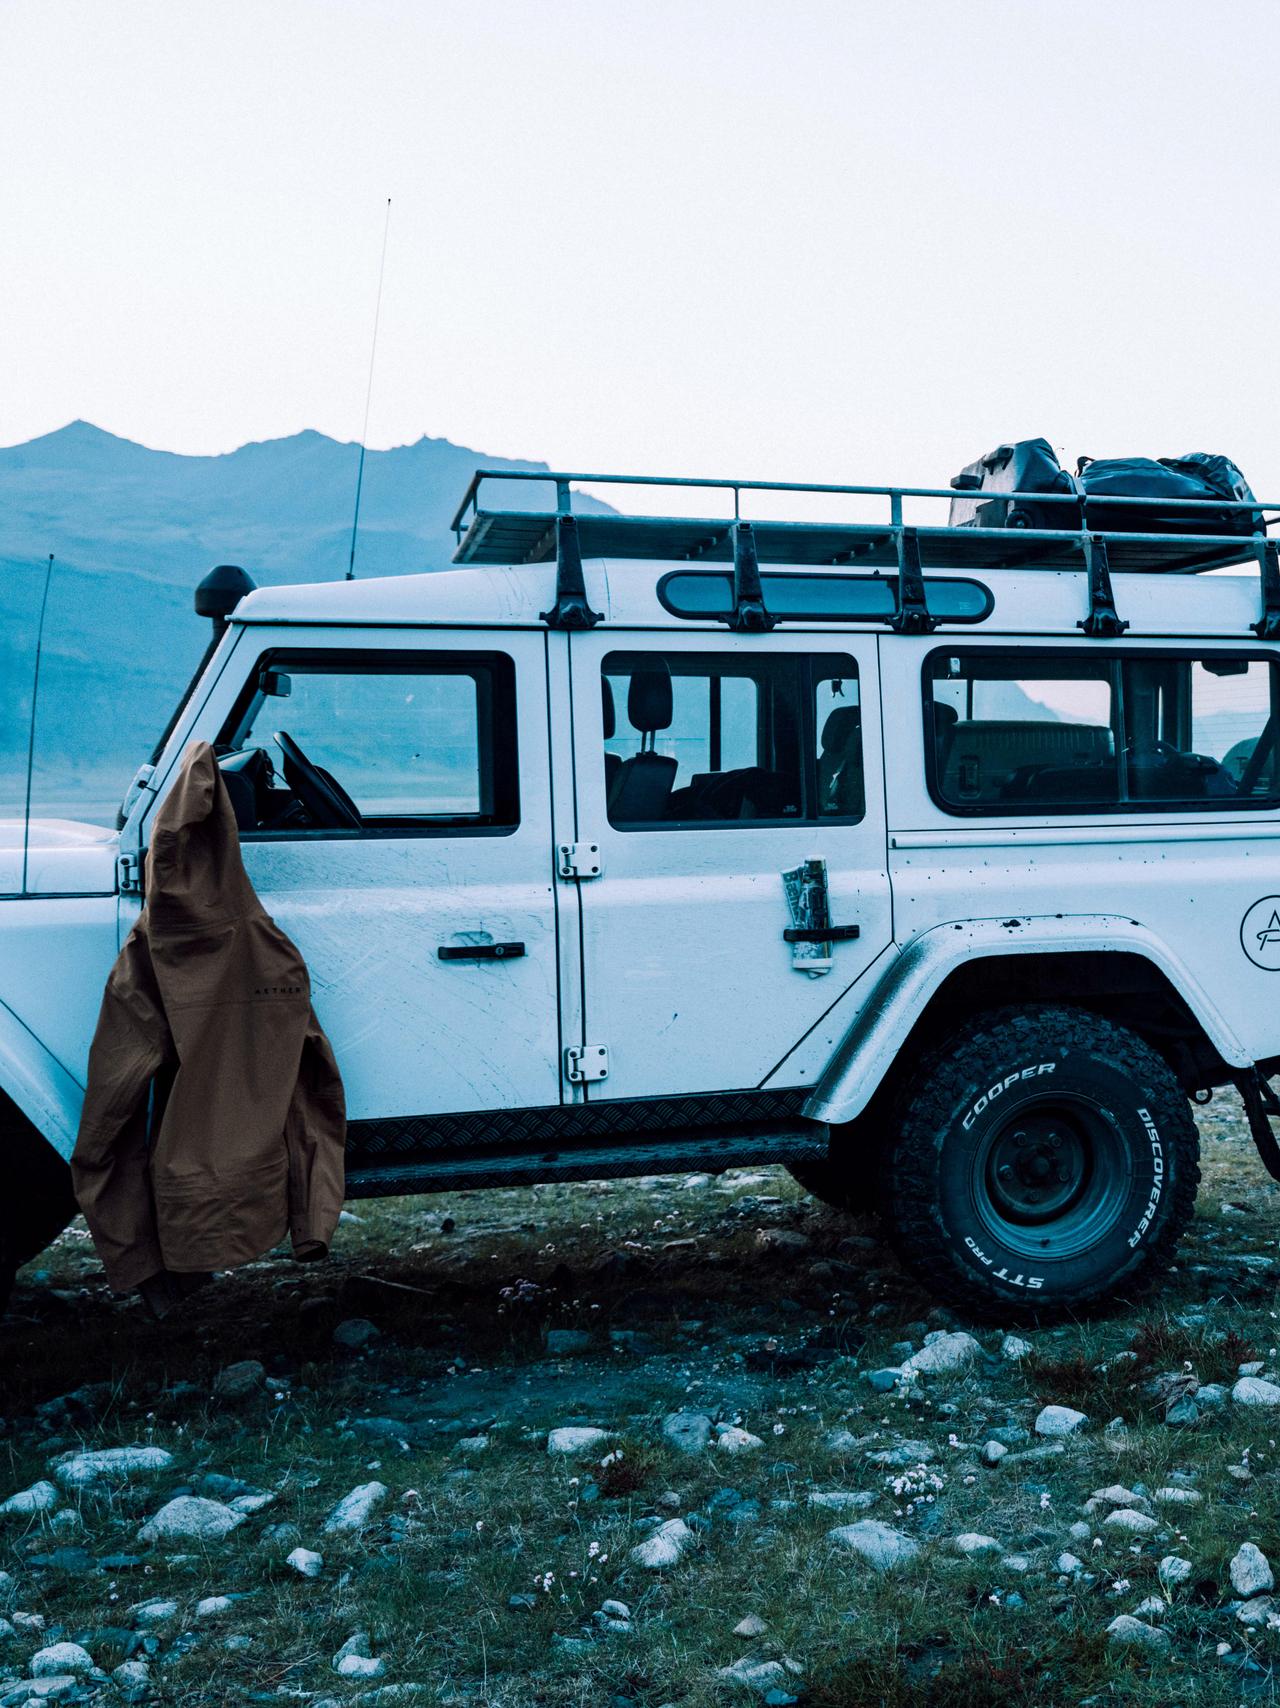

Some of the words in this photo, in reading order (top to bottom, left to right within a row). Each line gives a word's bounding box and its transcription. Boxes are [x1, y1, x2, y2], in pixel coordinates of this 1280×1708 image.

[961, 1062, 1057, 1131] COOPER
[1127, 1107, 1164, 1249] DISCOVERER
[963, 1236, 993, 1266] PRO
[992, 1266, 1045, 1289] STT
